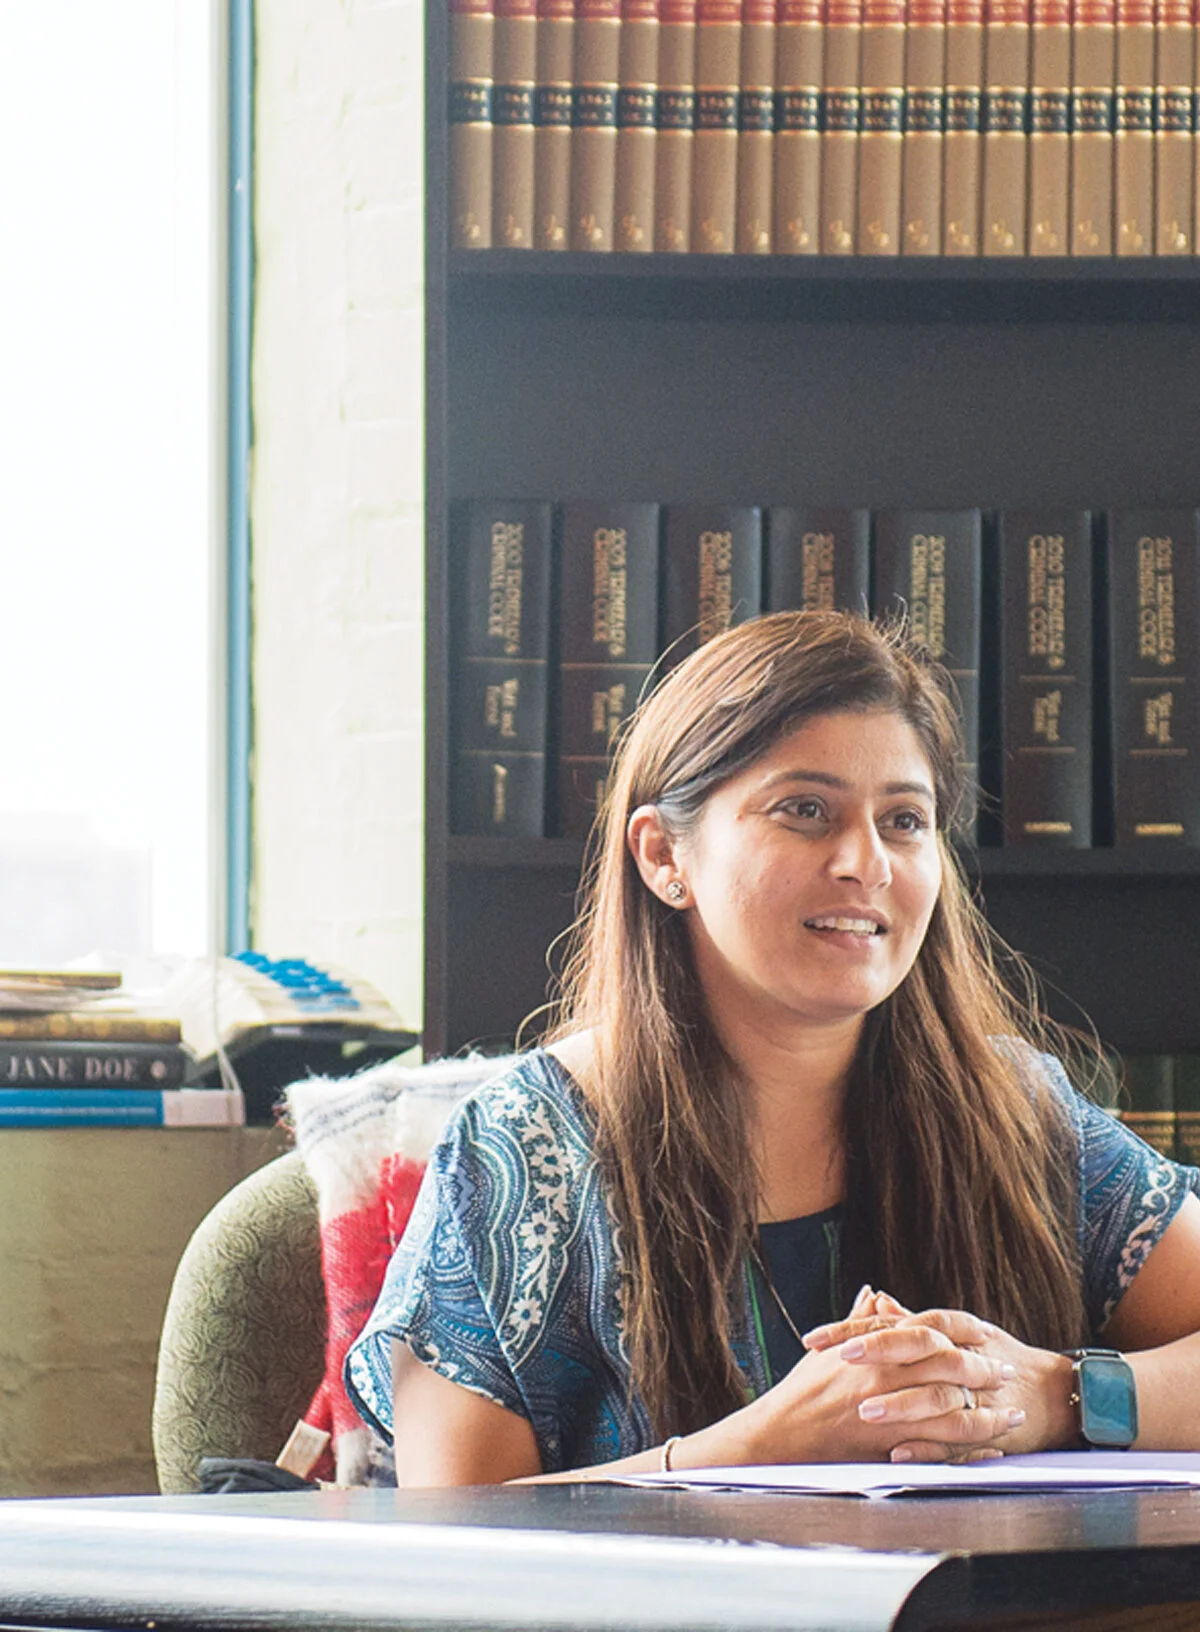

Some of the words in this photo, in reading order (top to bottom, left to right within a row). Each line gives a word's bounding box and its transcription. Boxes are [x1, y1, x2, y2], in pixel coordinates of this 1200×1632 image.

[1139, 608, 1157, 658] CODE
[7, 1056, 74, 1081] JANE
[85, 1057, 138, 1081] DOE
